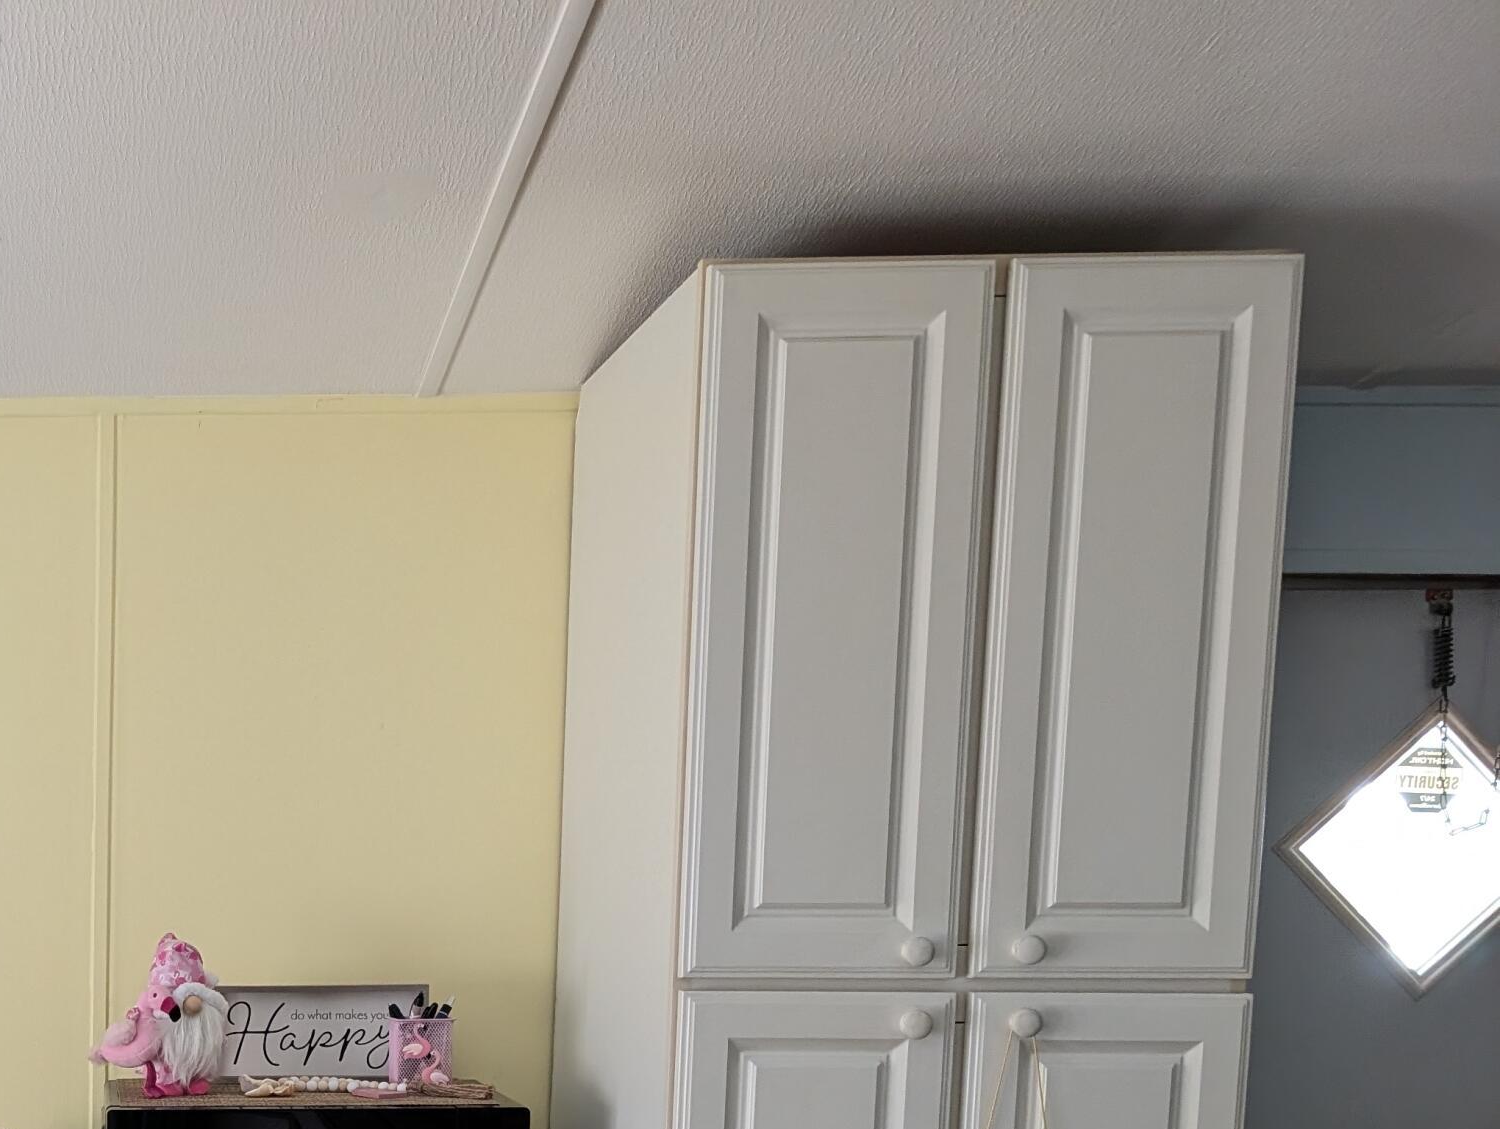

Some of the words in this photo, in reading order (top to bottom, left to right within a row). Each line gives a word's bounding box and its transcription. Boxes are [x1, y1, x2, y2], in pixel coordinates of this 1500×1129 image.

[225, 1001, 390, 1069] Happy
[290, 1009, 305, 1020] do
[307, 1009, 332, 1020] what
[335, 1009, 368, 1020] makes
[370, 1012, 389, 1023] you
